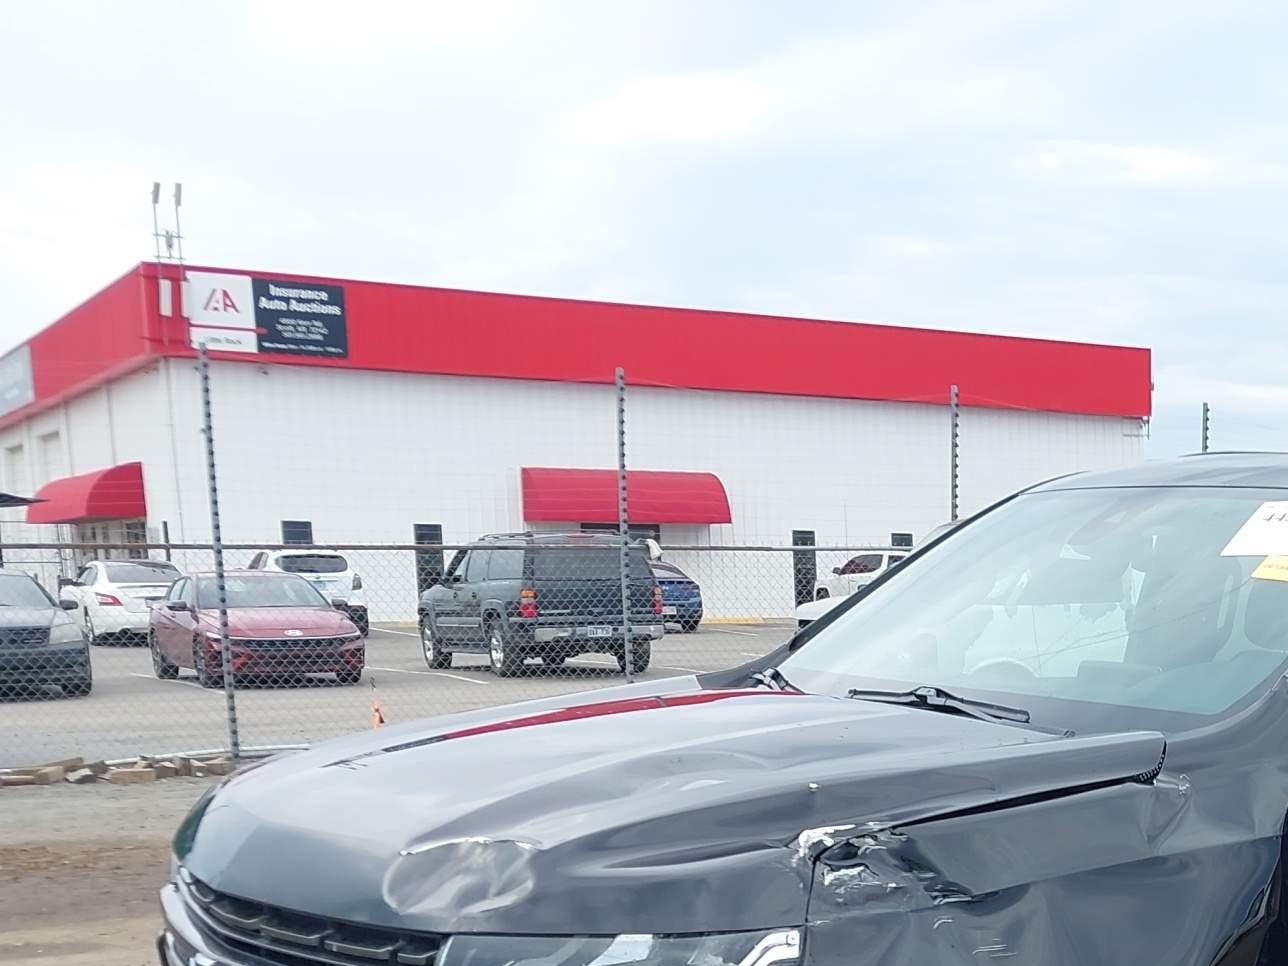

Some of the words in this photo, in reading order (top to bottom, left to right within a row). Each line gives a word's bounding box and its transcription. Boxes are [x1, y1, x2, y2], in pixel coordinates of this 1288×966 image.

[268, 283, 329, 301] Insurance
[257, 296, 288, 311] Auto
[288, 298, 342, 316] Auctions
